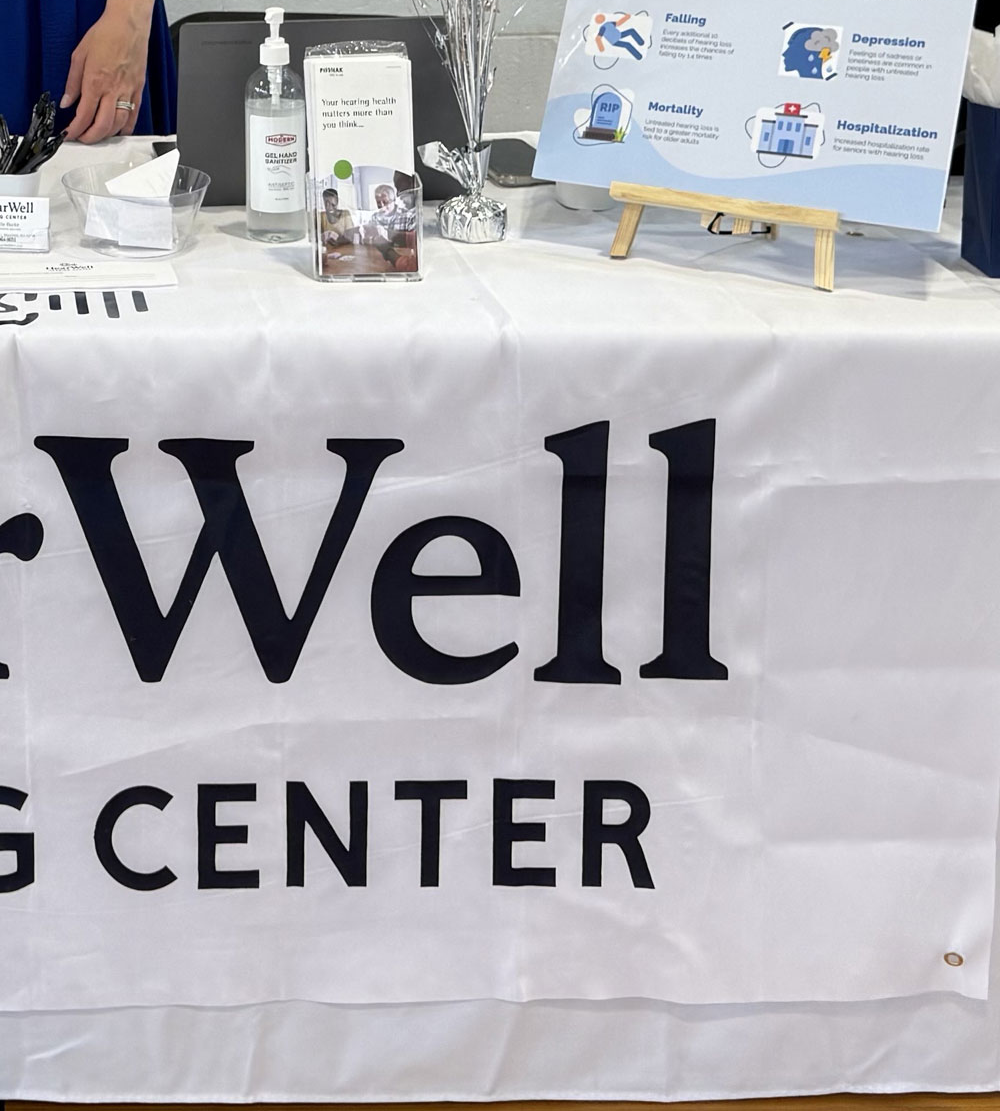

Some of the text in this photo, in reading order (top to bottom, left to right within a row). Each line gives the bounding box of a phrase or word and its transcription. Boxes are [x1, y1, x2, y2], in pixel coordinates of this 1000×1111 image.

[665, 13, 706, 26] Falling
[852, 34, 926, 48] Depression
[341, 98, 370, 107] hearing
[600, 102, 620, 113] RIP
[648, 102, 703, 117] Mortality
[837, 120, 938, 139] Hospitalization
[843, 146, 866, 155] seniors
[868, 147, 881, 155] with
[883, 149, 909, 160] hearing
[910, 152, 924, 160] loss
[92, 778, 656, 893] CENTER
